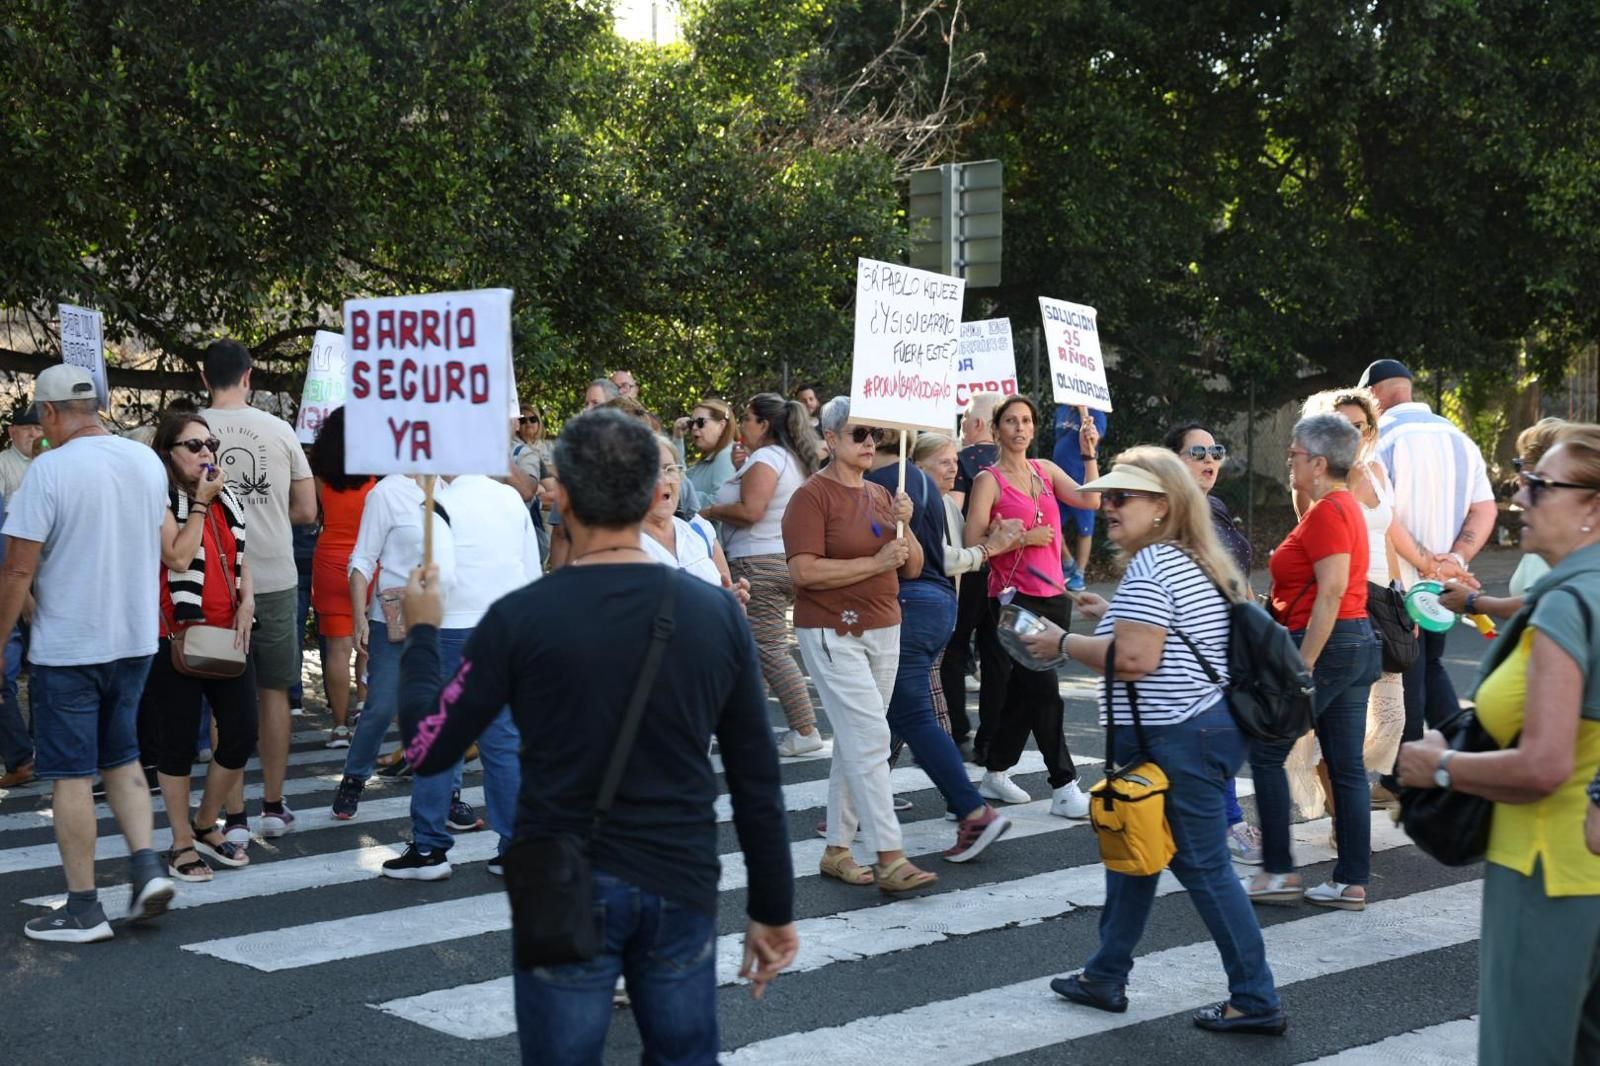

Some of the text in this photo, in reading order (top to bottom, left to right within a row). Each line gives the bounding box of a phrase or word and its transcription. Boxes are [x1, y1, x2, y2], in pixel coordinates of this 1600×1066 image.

[882, 267, 919, 296] PABLO
[1063, 329, 1081, 347] 35
[894, 340, 923, 368] FUERA
[1058, 346, 1096, 372] AÑOS
[352, 358, 489, 404] SEGURO
[1056, 372, 1110, 401] OLVIDADOS
[388, 416, 433, 462] YA
